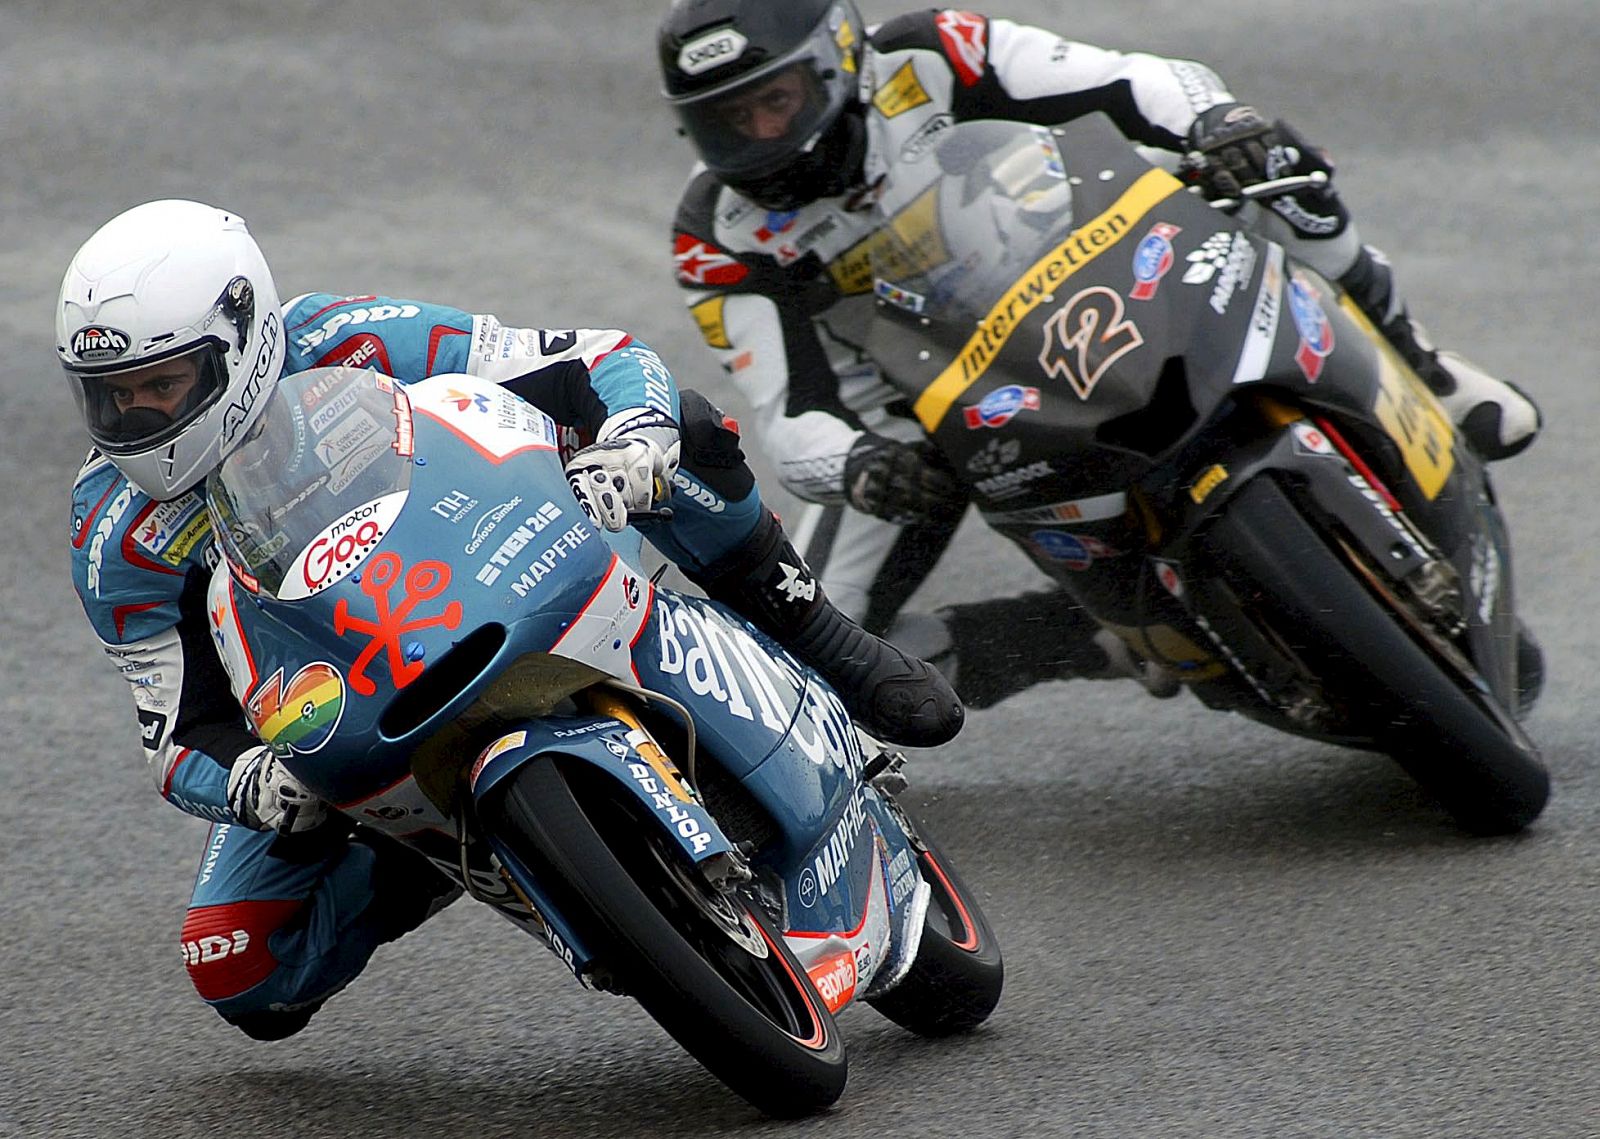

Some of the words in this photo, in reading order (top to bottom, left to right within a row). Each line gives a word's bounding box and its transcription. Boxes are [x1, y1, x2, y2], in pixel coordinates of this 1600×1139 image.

[960, 212, 1130, 382] Interwetten
[73, 329, 127, 354] Airoh
[311, 339, 377, 399] MAPFRE
[1038, 285, 1144, 401] 12
[222, 311, 279, 447] Airoh
[331, 501, 381, 539] motor
[464, 521, 497, 556] Gaviota
[492, 495, 523, 524] Simbac
[673, 473, 726, 514] PIDI
[303, 520, 379, 589] Goo
[510, 521, 592, 598] MAPFRE
[628, 763, 712, 855] DUNLOP
[814, 780, 867, 897] MAPFRE
[816, 959, 856, 1004] aprilia
